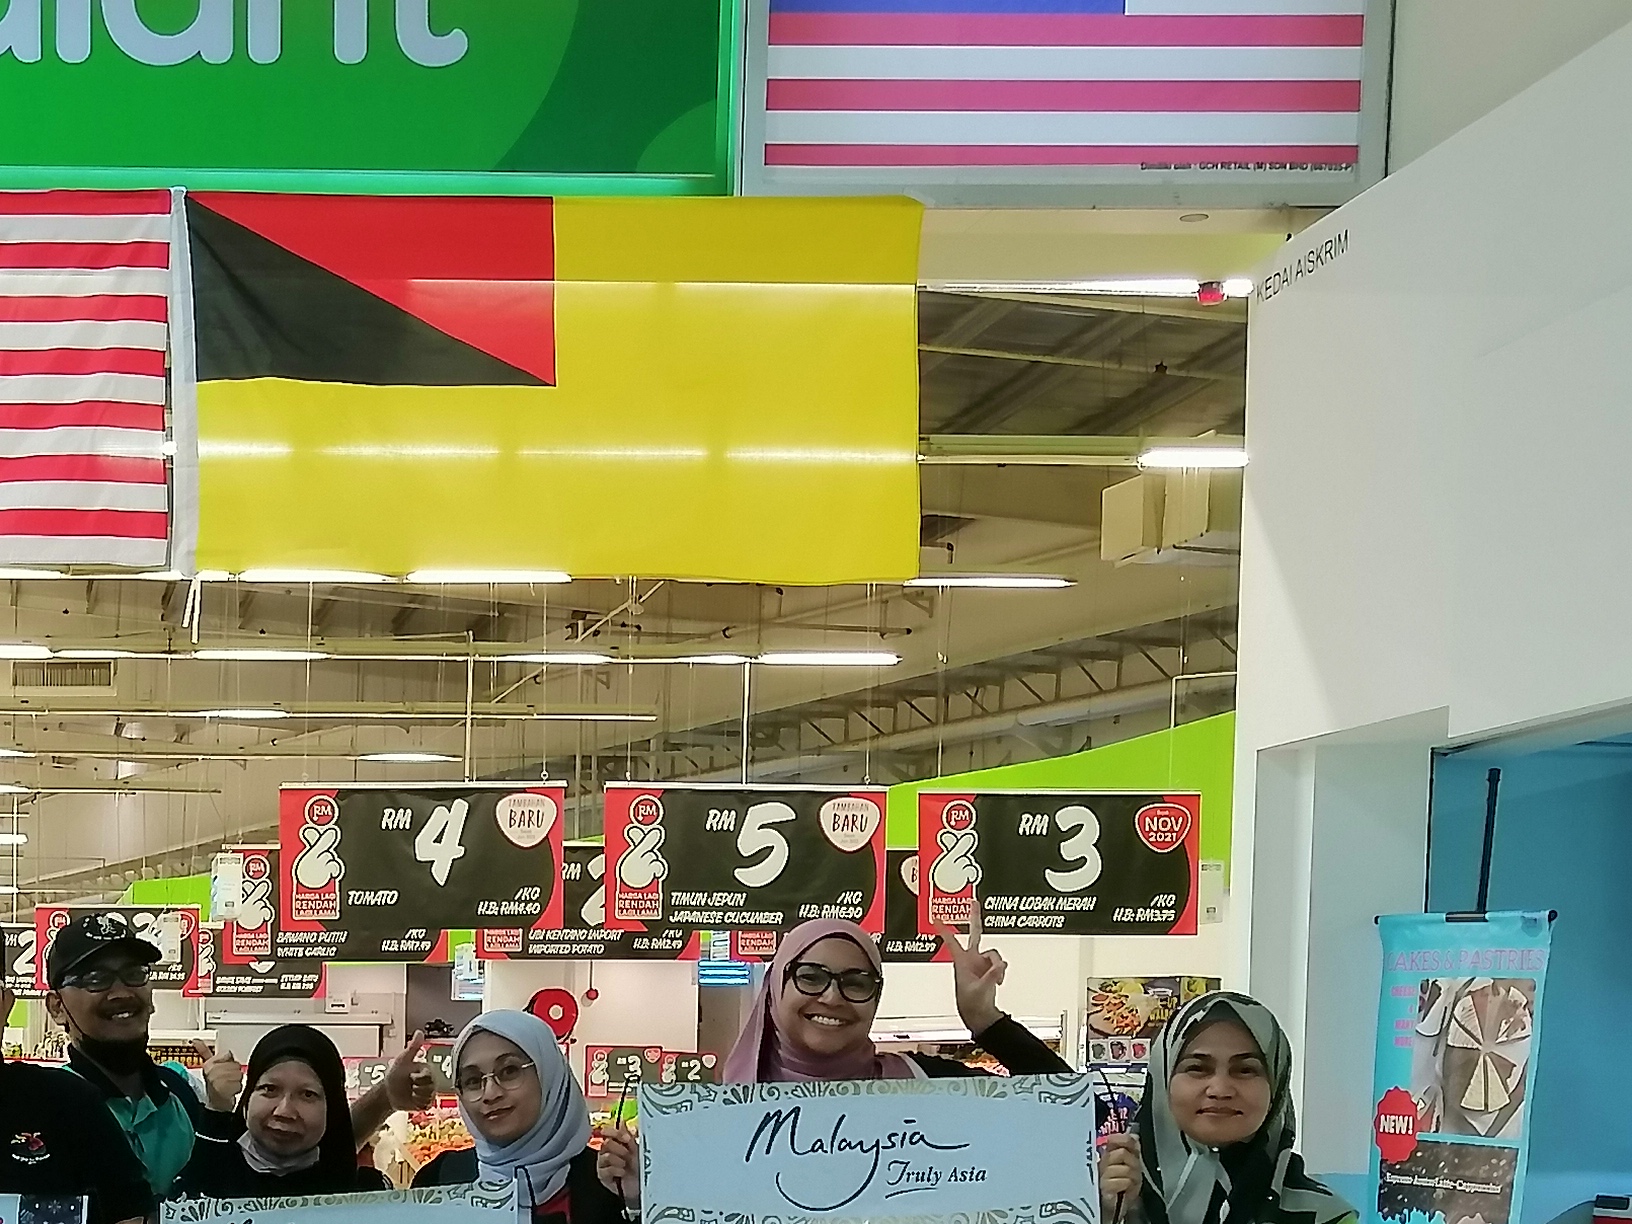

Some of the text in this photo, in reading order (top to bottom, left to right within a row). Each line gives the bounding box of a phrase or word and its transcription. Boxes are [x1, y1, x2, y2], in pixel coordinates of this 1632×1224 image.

[1256, 229, 1349, 306] KEDAI AISKRIM
[508, 808, 545, 829] BARU
[831, 813, 869, 833] BARU
[1144, 816, 1184, 832] NOV
[381, 798, 469, 887] RM 4
[705, 801, 797, 888] RM 5
[1148, 832, 1177, 842] 2021
[1018, 805, 1103, 893] RM 3
[295, 900, 336, 910] RENDAH
[347, 889, 399, 906] TOMATO
[618, 900, 659, 909] RENDAH
[669, 892, 707, 907] TIMUN
[984, 896, 1097, 911] CHINA LOBAK MERAH
[668, 910, 784, 925] JAPANESE CUCUMBER
[984, 915, 1065, 928] CHINA CARROTS
[1459, 949, 1547, 972] PASTRIES
[1379, 1114, 1414, 1135] NEW!
[744, 1105, 970, 1211] Malaysia
[885, 1159, 988, 1186] Truly Asia
